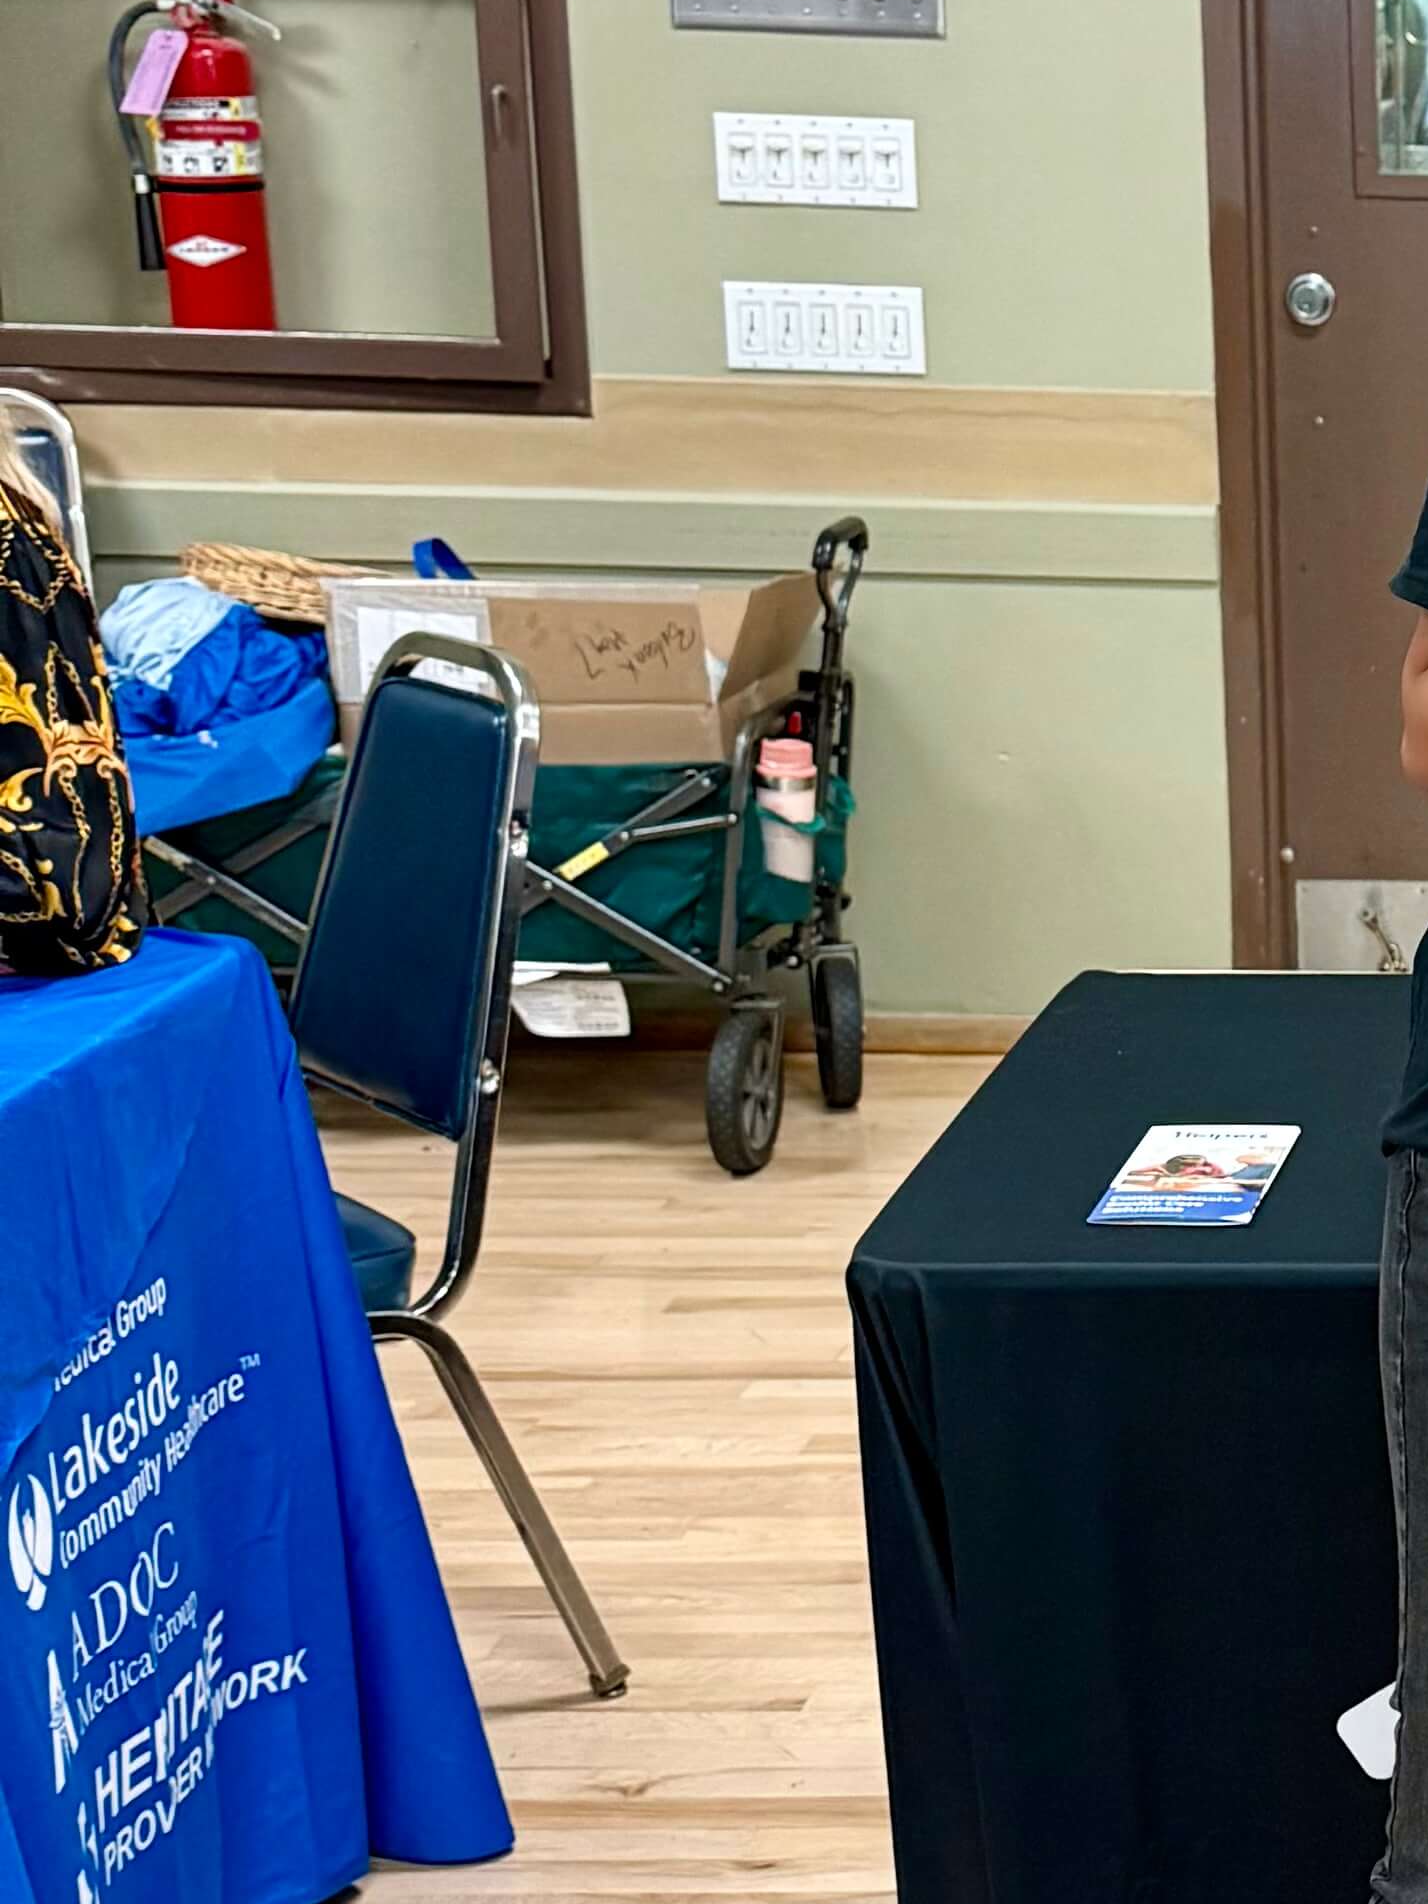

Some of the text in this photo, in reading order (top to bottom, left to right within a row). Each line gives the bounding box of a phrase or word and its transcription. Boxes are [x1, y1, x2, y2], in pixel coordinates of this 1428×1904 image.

[53, 1276, 167, 1392] edical Group
[48, 1352, 181, 1515] Lakeside
[58, 1452, 162, 1570] Community
[71, 1521, 180, 1683] ADOC
[78, 1590, 199, 1737] Medical Group
